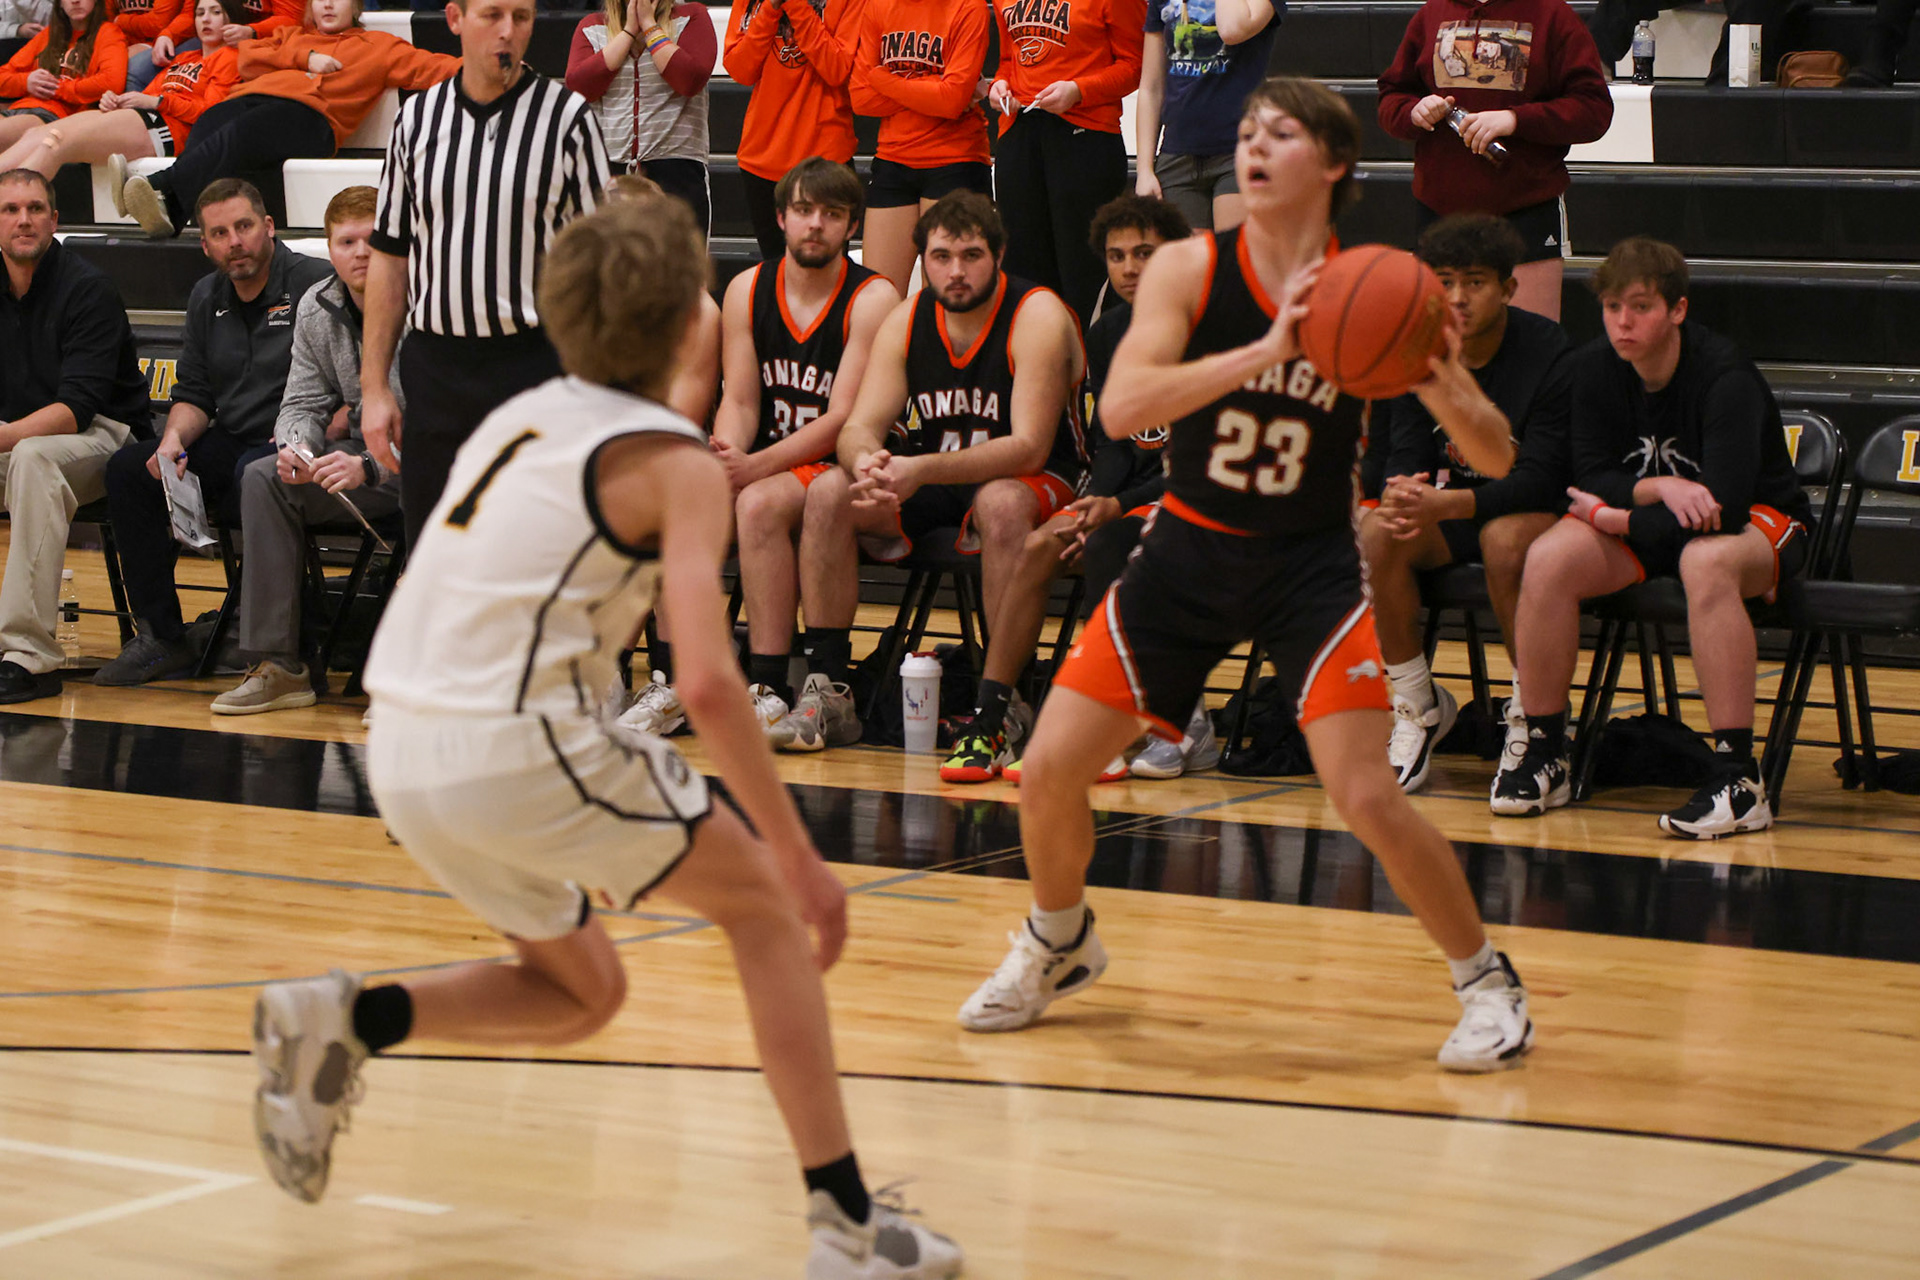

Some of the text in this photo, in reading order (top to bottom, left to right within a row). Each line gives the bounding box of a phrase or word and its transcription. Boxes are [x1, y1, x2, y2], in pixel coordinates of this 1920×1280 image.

[762, 358, 833, 399] ONAGA
[917, 386, 1000, 422] ONAGA
[1243, 359, 1340, 413] AGA
[1205, 406, 1312, 498] 23
[442, 427, 544, 532] 1
